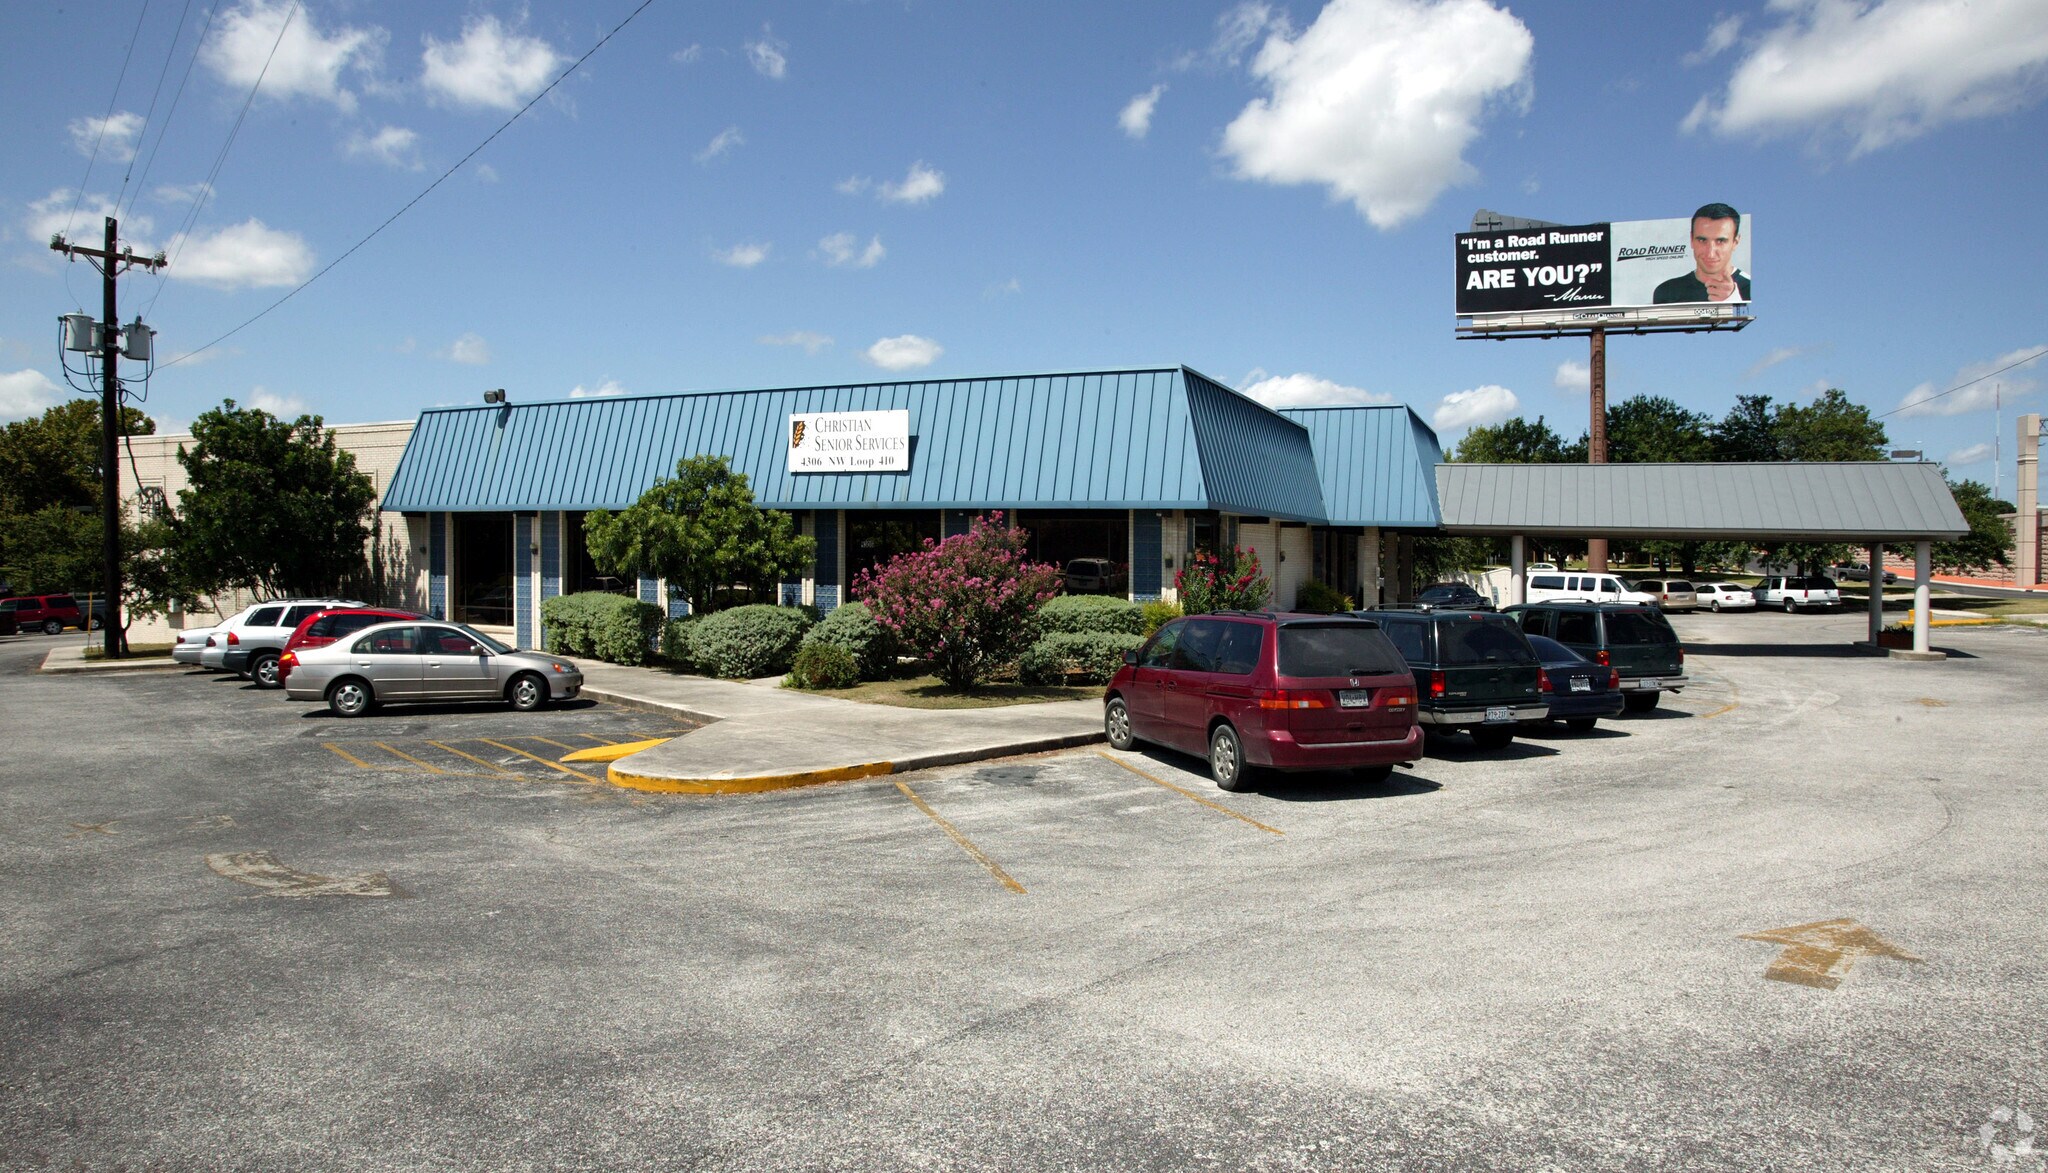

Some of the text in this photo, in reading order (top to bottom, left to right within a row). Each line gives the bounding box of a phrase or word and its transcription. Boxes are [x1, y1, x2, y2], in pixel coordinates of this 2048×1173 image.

[1494, 239, 1503, 249] a
[1508, 233, 1546, 247] Road
[1549, 231, 1604, 245] Runner
[1467, 250, 1539, 263] customer.
[1619, 245, 1686, 256] ROAD RUNNER
[1466, 269, 1515, 290] ARE
[815, 417, 872, 433] CHRISTIAN
[814, 434, 905, 452] SENIOR SERVICES
[801, 456, 894, 468] 4306 NW Loop 410
